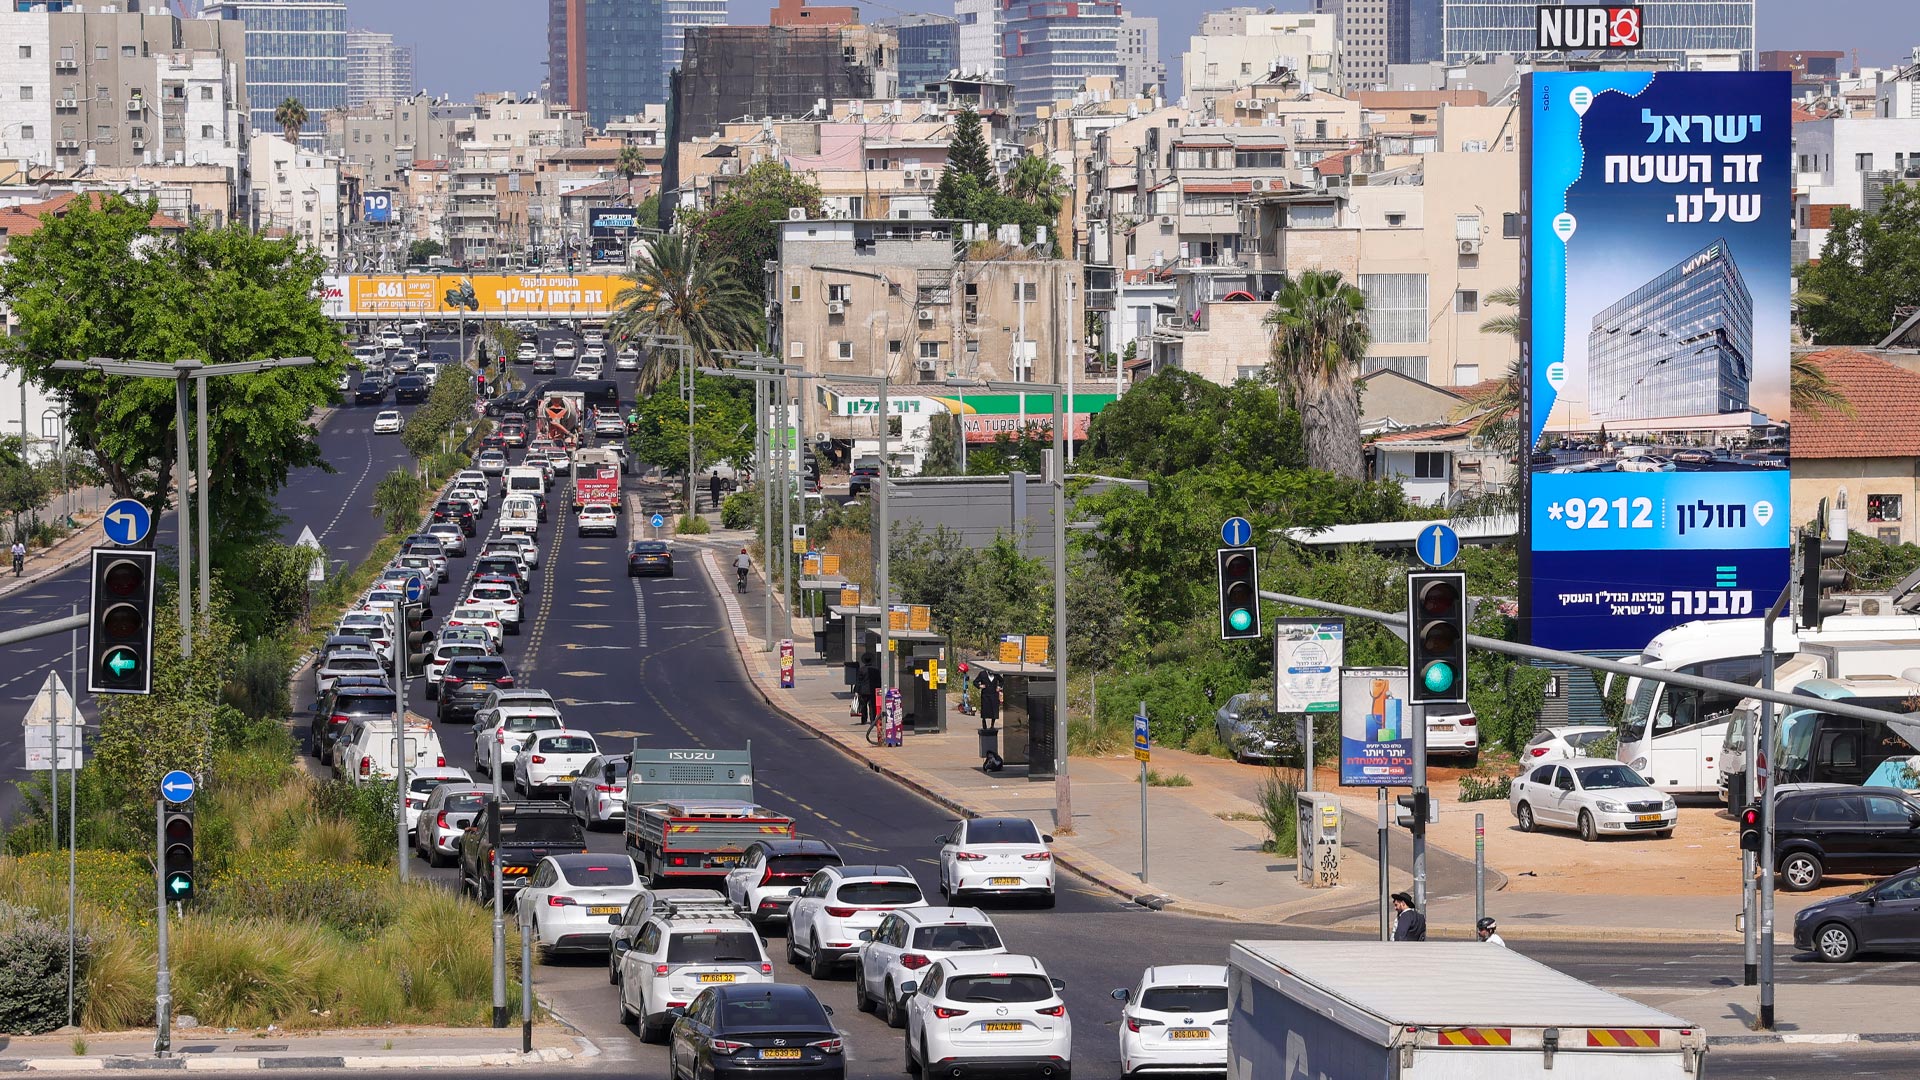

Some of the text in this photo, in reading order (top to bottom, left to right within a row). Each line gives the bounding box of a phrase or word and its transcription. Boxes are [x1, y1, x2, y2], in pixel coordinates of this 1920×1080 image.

[1542, 85, 1550, 111] sabio
[1641, 108, 1762, 143] ישראל
[1605, 154, 1762, 183] זה השטח
[1666, 187, 1761, 223] שלנו.
[377, 281, 403, 298] 861
[519, 277, 579, 288] תקועים בפקק?
[496, 288, 604, 306] זה הזמן לחילוף
[893, 400, 920, 413] דור
[1676, 499, 1746, 535] חולון
[1558, 590, 1665, 605] קבוצת הנדל"ן העסקי
[1671, 590, 1752, 615] מבנה
[1610, 604, 1665, 616] של ישראל
[669, 752, 715, 760] ISUZU
[1346, 757, 1413, 766] ברים למאוחדת
[1362, 749, 1406, 757] יותר ויותר
